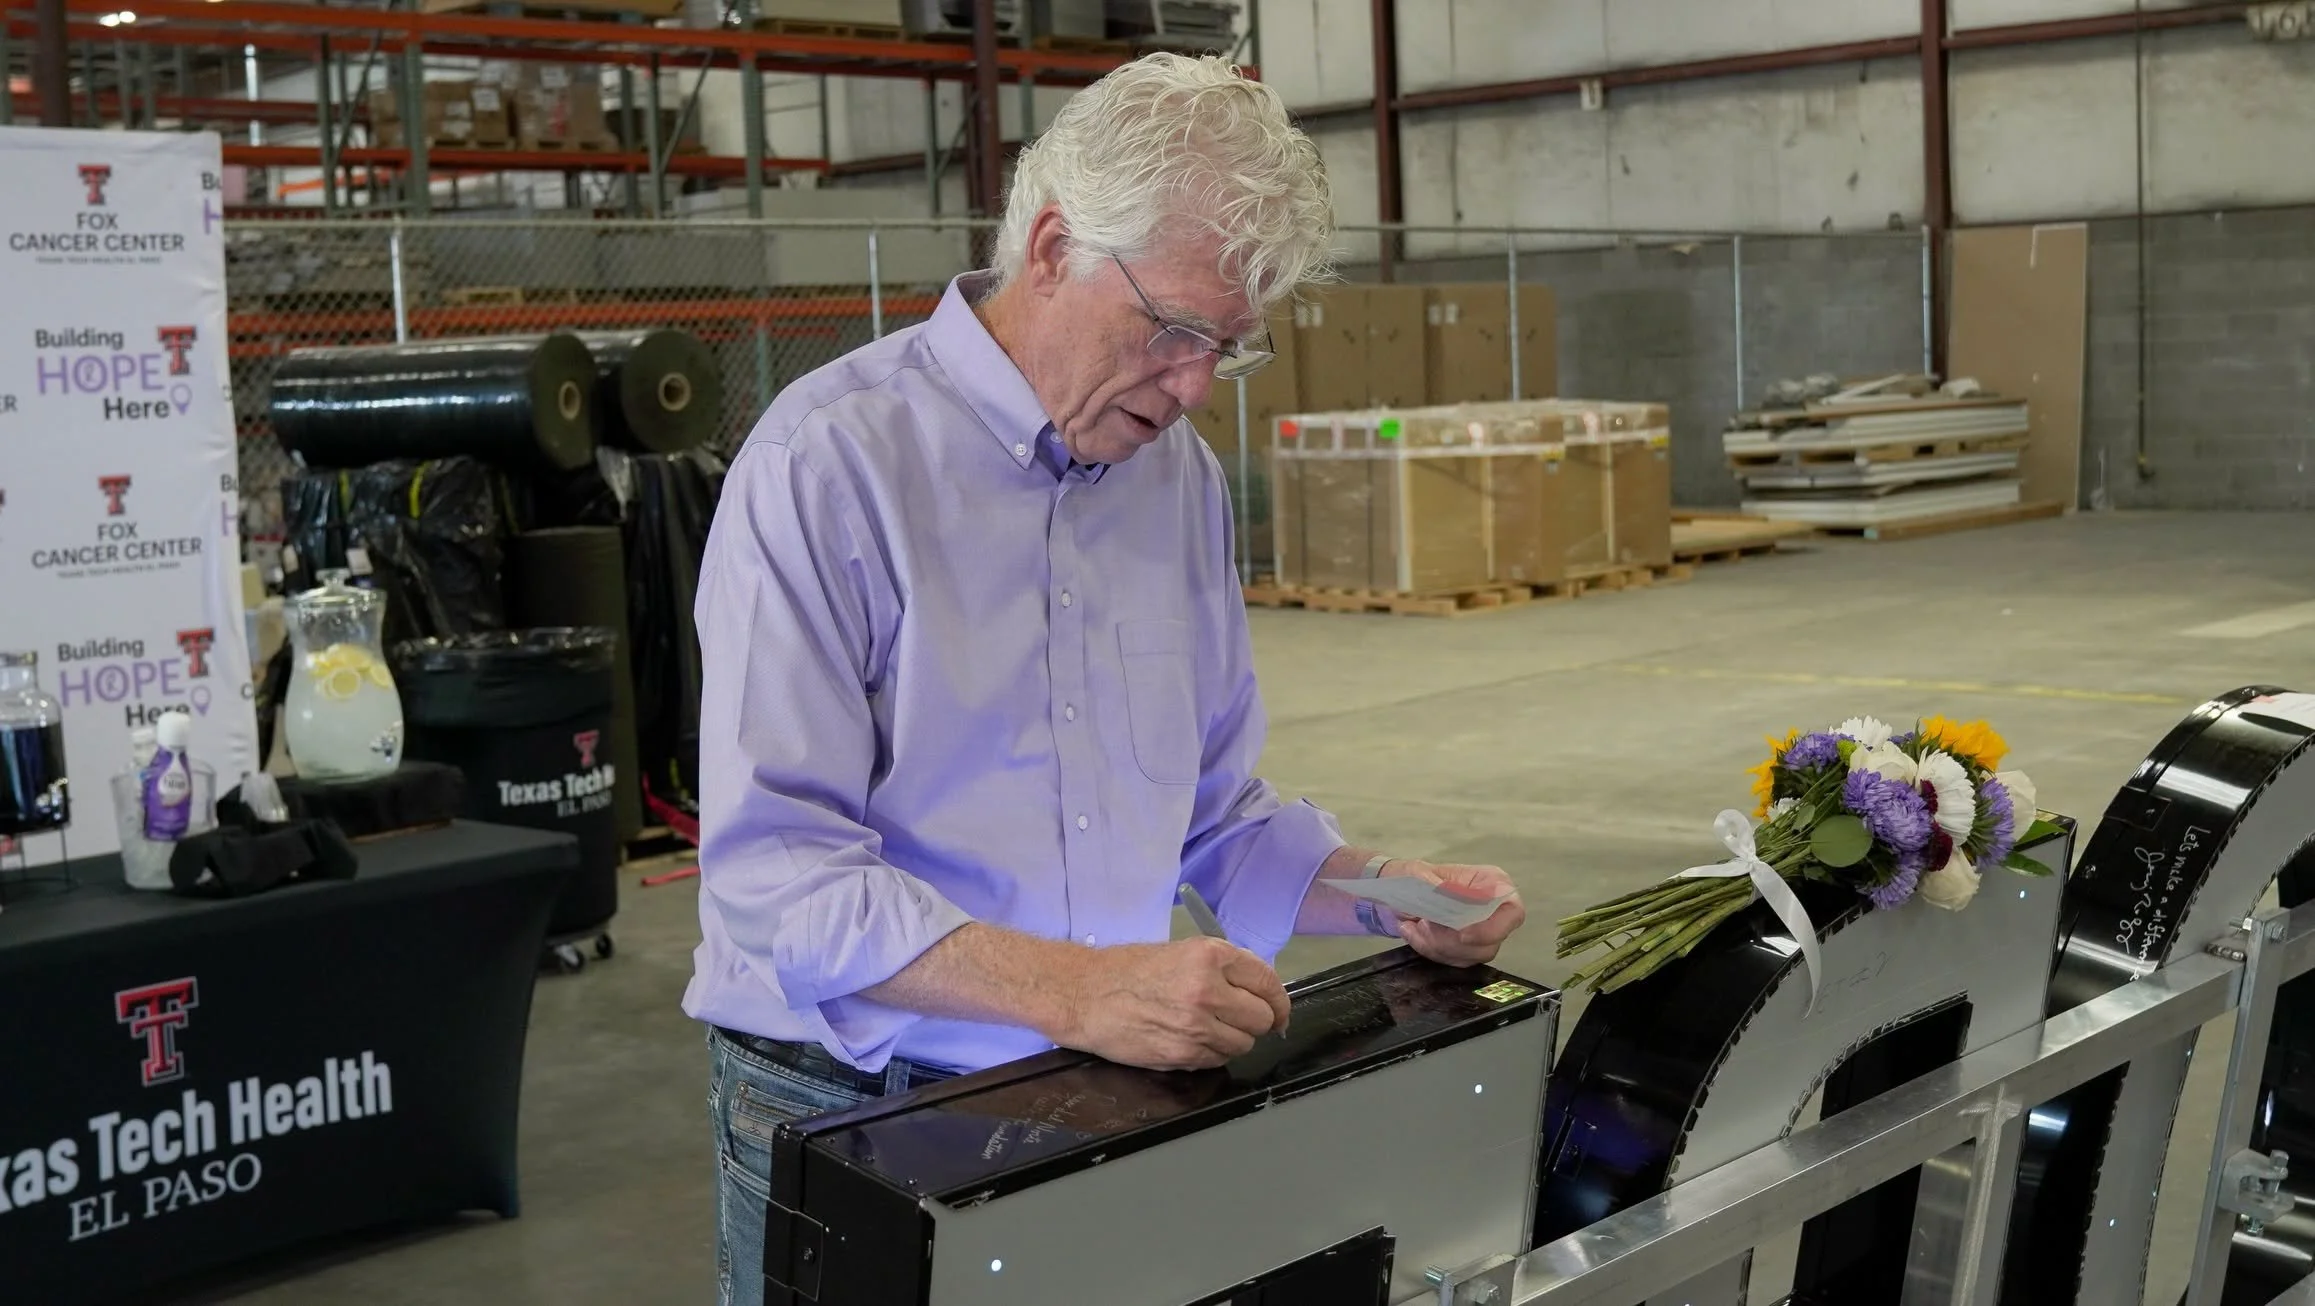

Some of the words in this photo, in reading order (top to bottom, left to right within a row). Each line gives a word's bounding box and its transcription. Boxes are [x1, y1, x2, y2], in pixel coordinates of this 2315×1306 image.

[77, 214, 118, 230] FOX
[9, 233, 98, 251] CANCER
[104, 233, 184, 251] CENTER
[36, 329, 124, 350] Building
[37, 354, 164, 395] HOPE
[104, 397, 170, 420] Here
[98, 522, 138, 541] FOX
[31, 546, 119, 569] CANCER
[124, 537, 202, 560] CENTER
[58, 638, 144, 662] Building
[59, 658, 184, 708] HOPE
[497, 779, 562, 807] Texas
[563, 767, 603, 798] Tech
[89, 1089, 216, 1183] Tech
[228, 1050, 392, 1146] Health
[68, 1191, 129, 1242] EL
[143, 1153, 262, 1218] PASO
